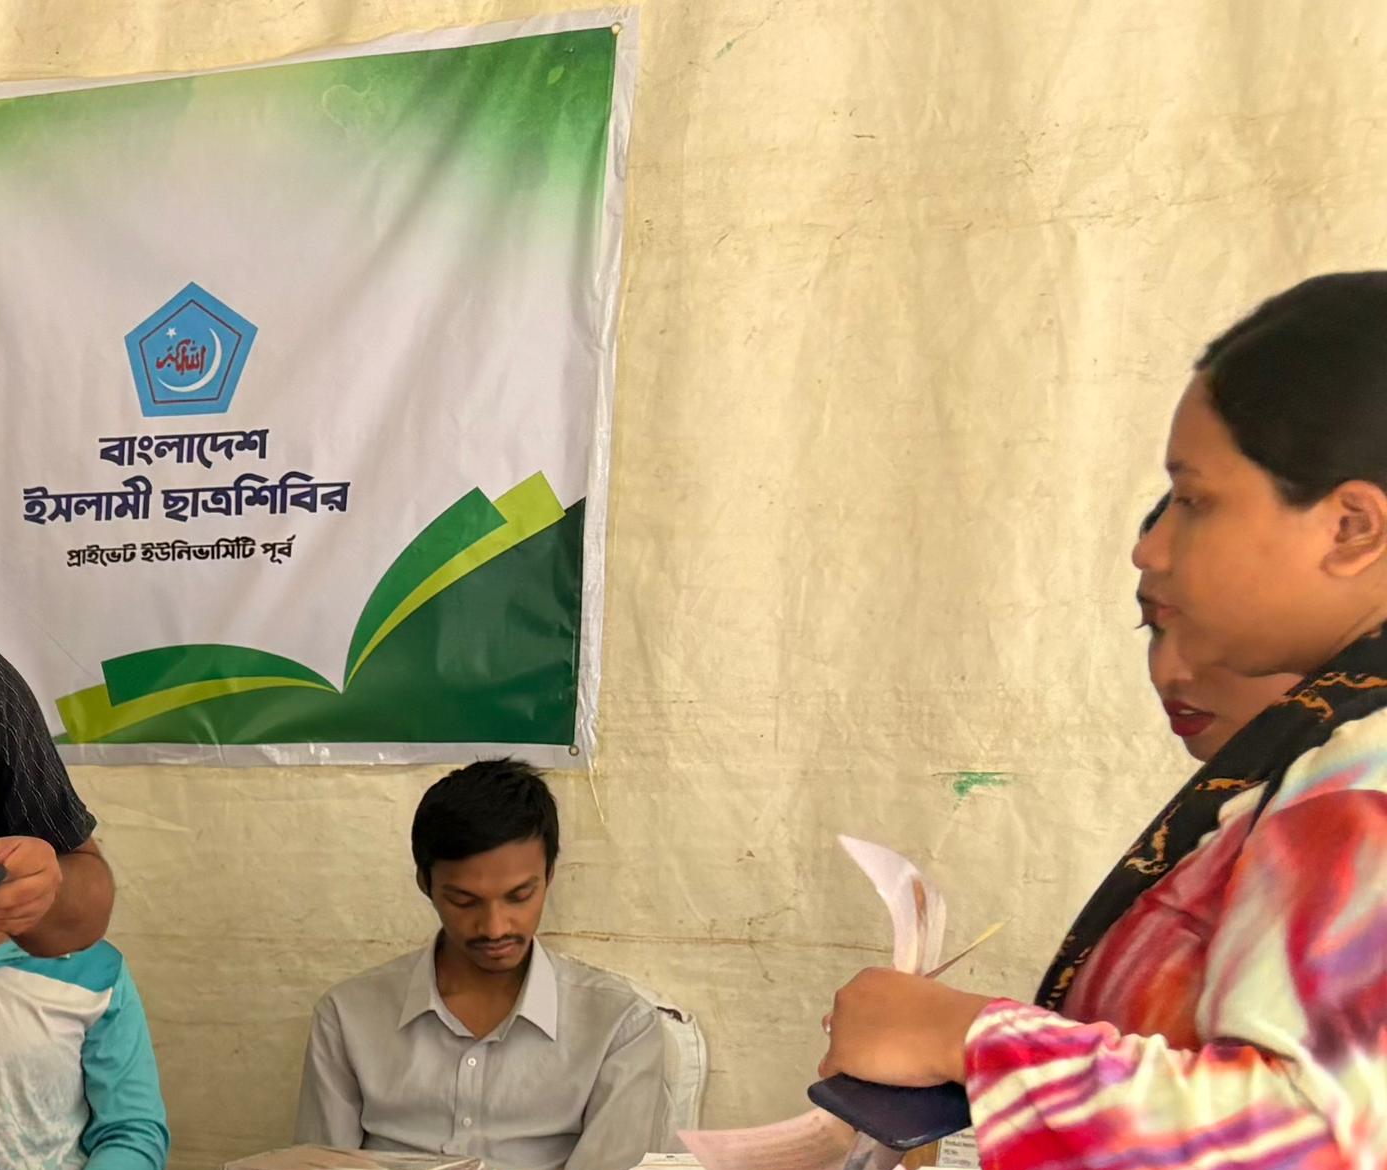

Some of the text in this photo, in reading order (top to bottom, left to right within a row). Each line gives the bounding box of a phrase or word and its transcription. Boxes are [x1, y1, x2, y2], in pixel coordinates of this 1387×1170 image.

[99, 428, 268, 469] বাংলাদেশ
[23, 471, 351, 526] ইসলামী ছাত্রশিবির
[67, 535, 296, 567] প্রাইভেট ইউনিভার্সিটি পূর্ব
